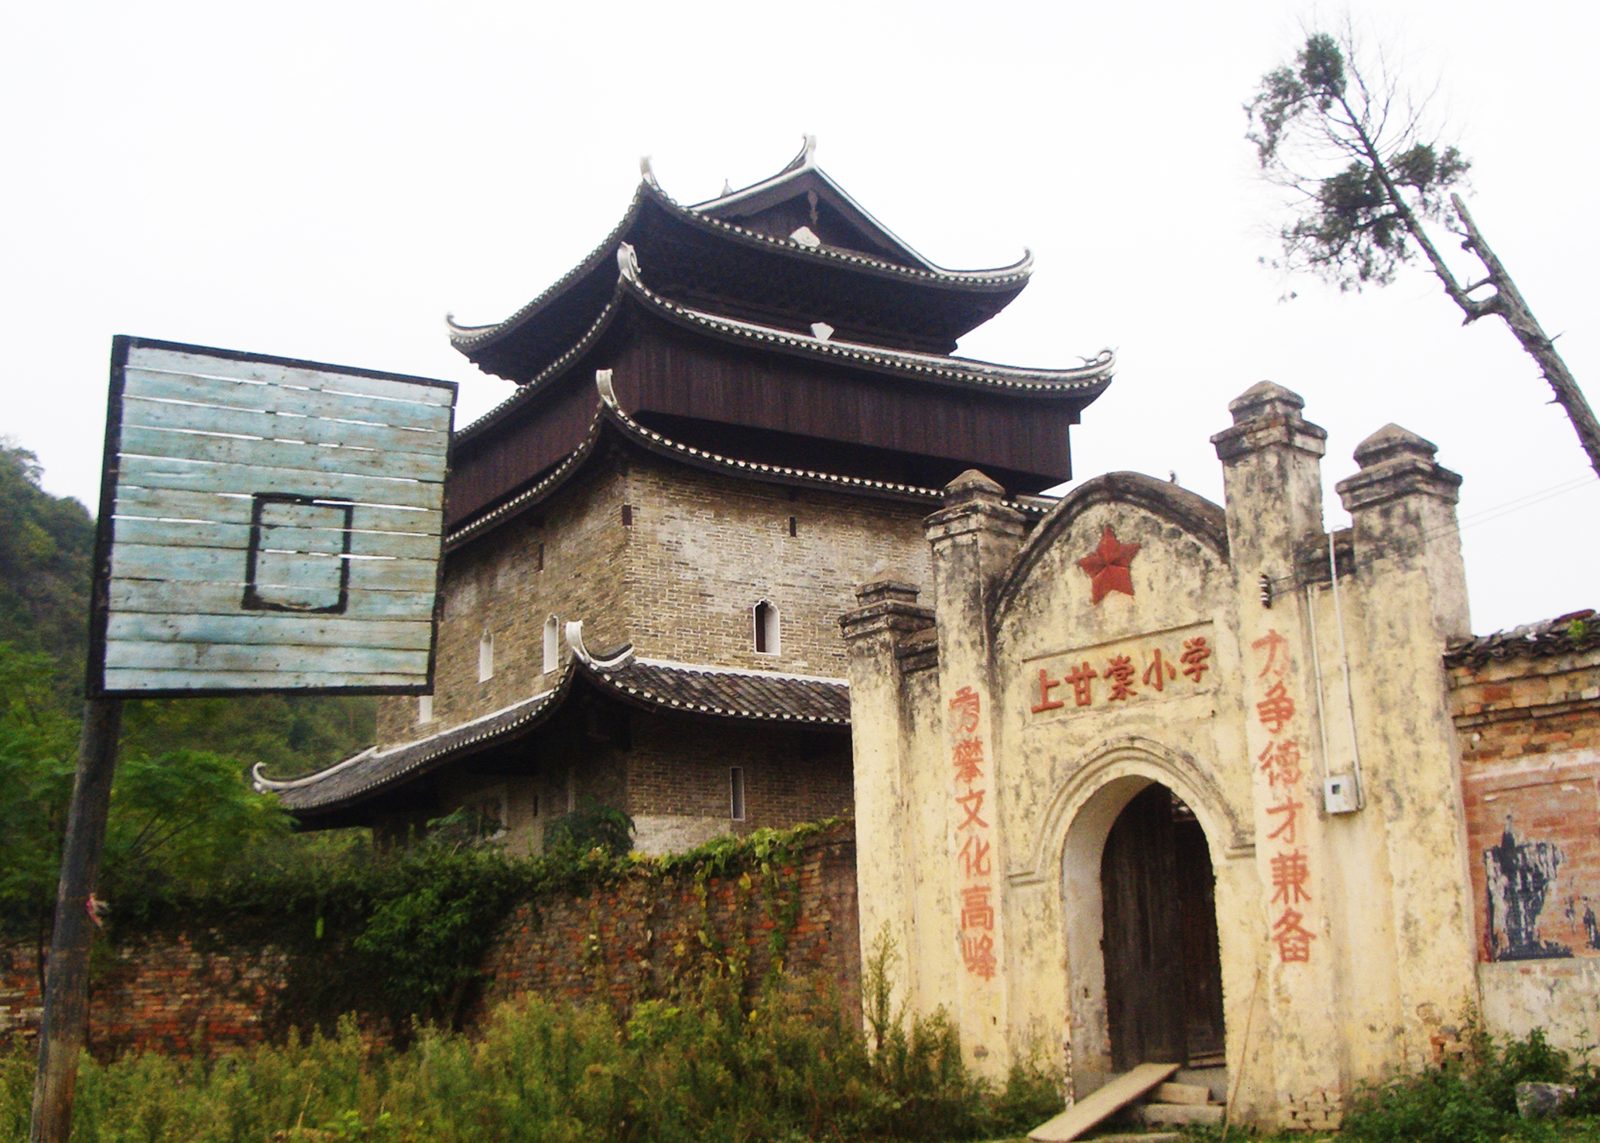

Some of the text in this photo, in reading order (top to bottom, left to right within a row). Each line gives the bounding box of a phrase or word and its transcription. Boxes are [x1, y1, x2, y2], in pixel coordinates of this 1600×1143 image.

[1031, 636, 1211, 714] 上甘棠小学
[1252, 630, 1316, 963] 力争德才兼备
